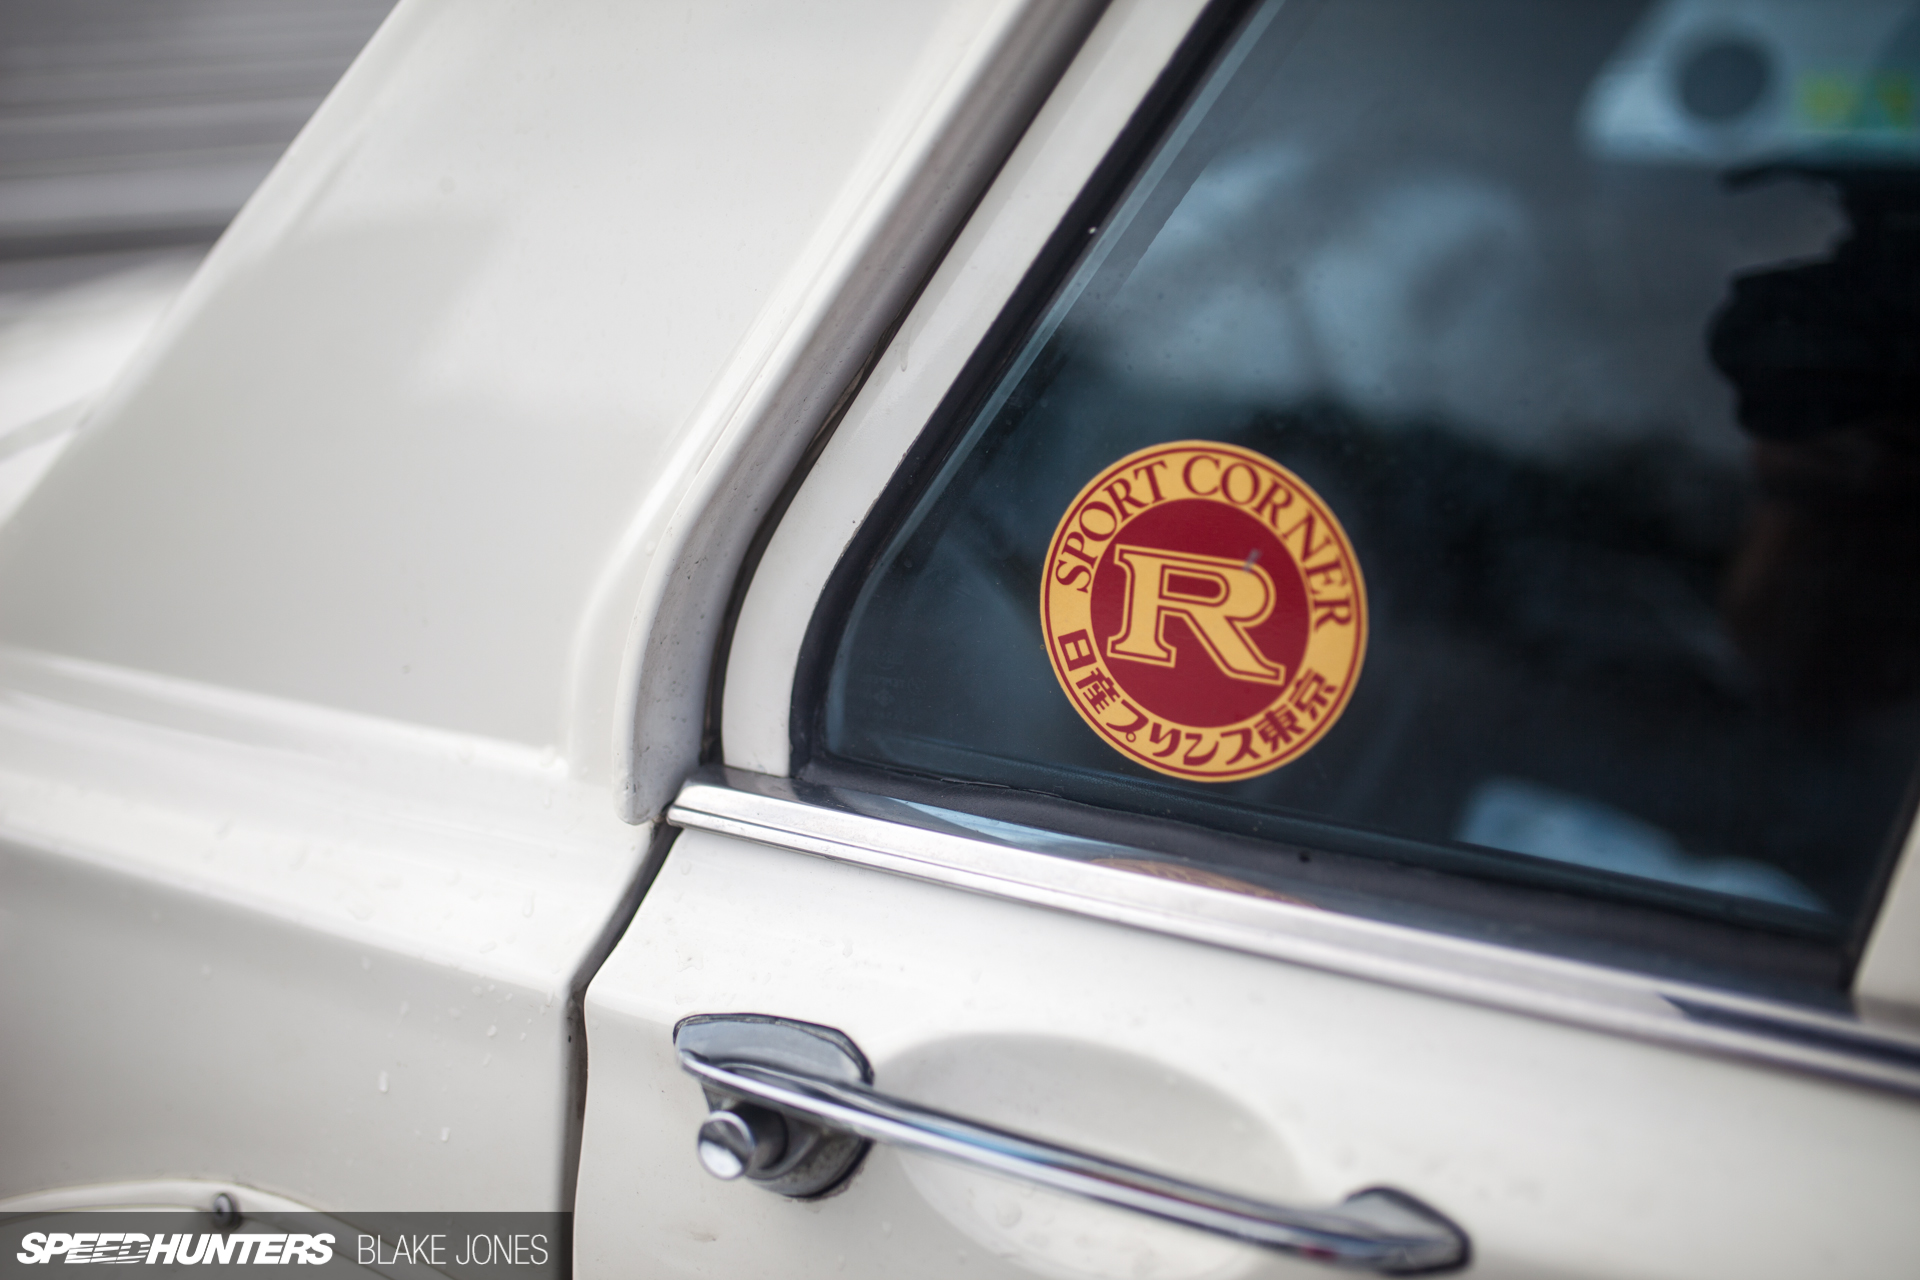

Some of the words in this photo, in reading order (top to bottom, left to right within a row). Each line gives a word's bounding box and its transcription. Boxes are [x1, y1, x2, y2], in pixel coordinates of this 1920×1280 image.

[1055, 460, 1168, 594] SPORT
[1182, 454, 1352, 634] CORNER
[1106, 543, 1287, 687] R
[1057, 628, 1338, 767] 日産プリンス東京
